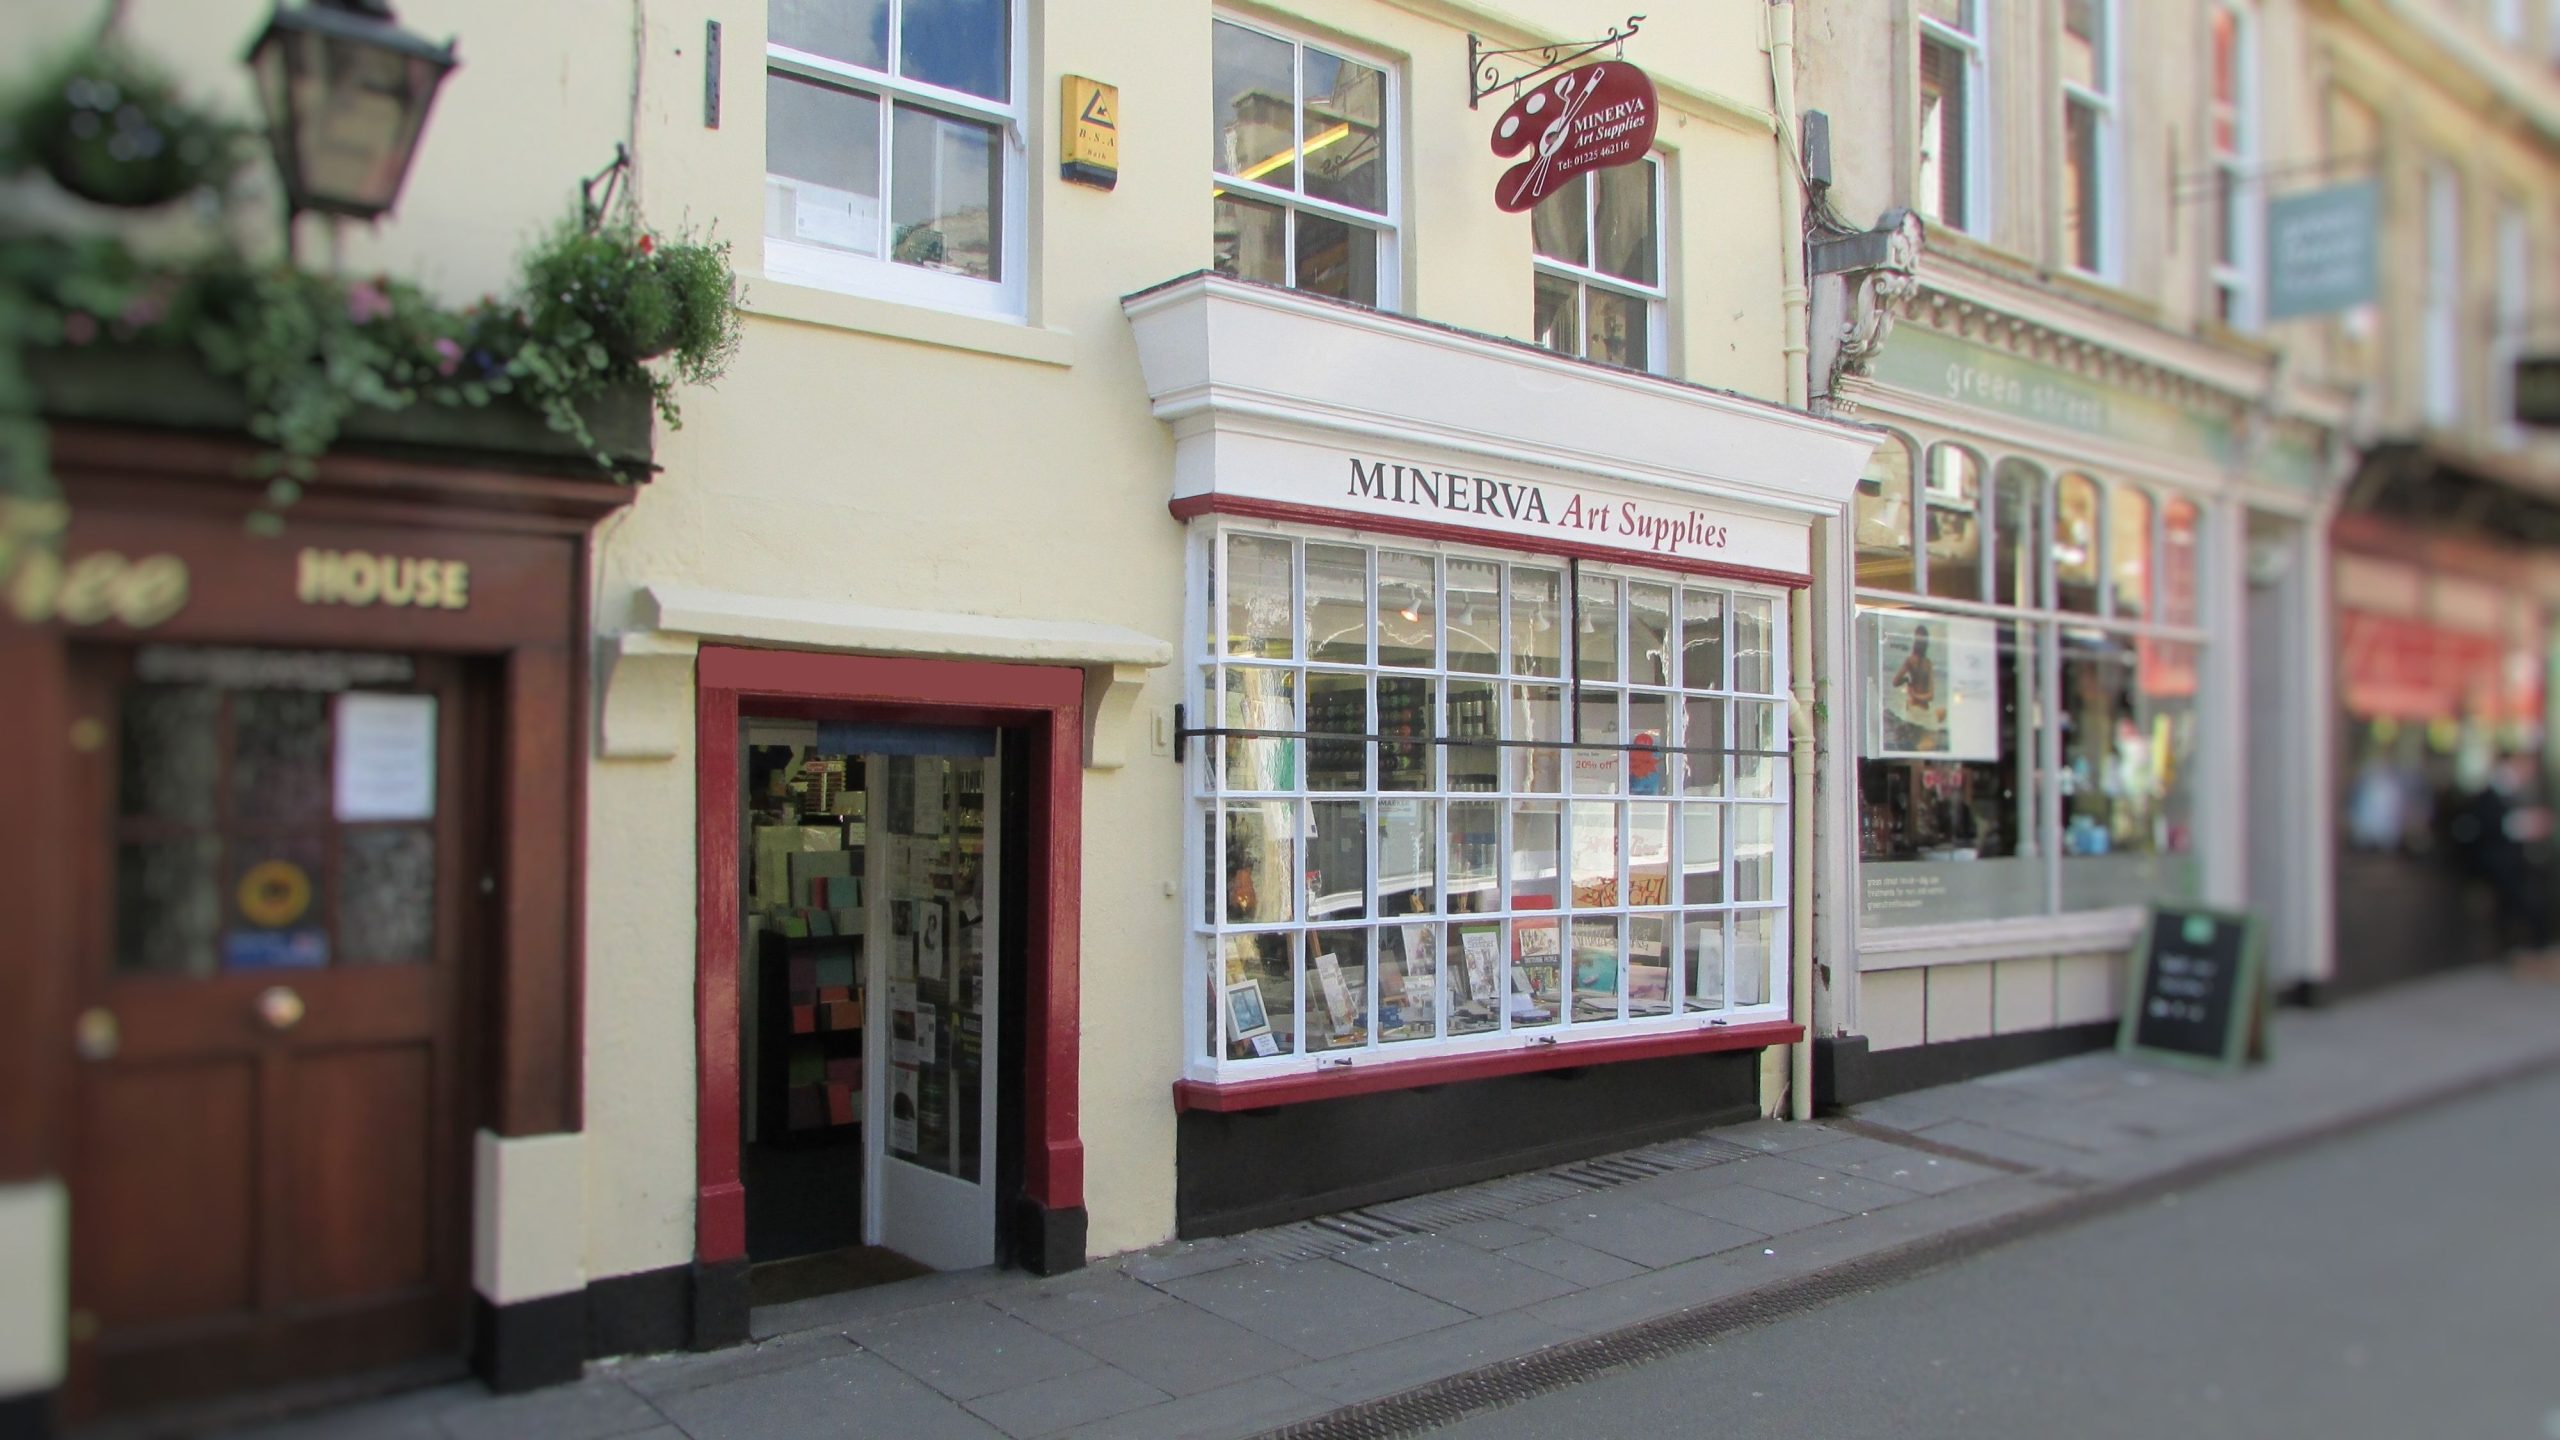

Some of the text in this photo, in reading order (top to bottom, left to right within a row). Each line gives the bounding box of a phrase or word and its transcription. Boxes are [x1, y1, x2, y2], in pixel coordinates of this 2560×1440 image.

[1574, 97, 1645, 134] MINERVA
[1574, 115, 1645, 149] Art Supplies
[1557, 141, 1630, 171] Tel: 01225 462116
[1946, 362, 2022, 405] green
[1346, 457, 1728, 553] MINERVA Art Supplies
[297, 547, 470, 610] HOUSE
